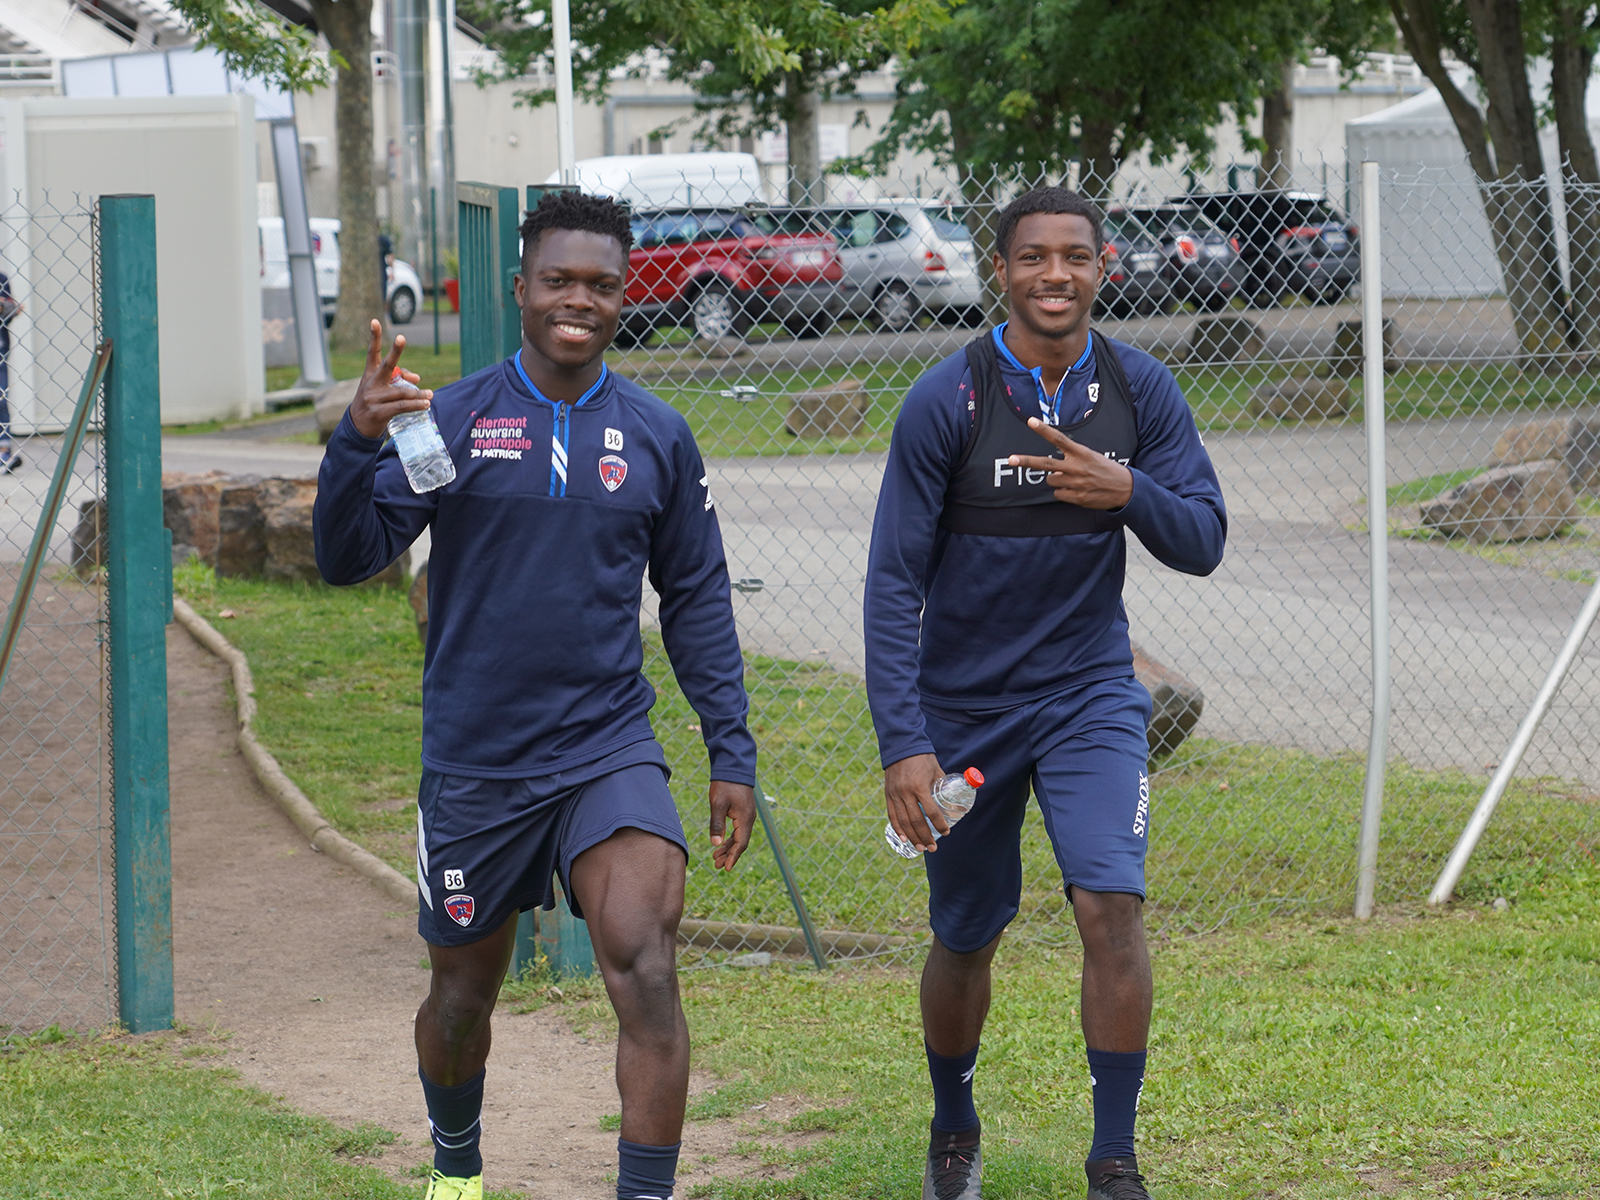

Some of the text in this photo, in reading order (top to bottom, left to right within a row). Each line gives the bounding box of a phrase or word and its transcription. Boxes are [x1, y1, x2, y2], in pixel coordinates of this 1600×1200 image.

[475, 416, 527, 428] clermont
[470, 428, 522, 439] auvergne
[607, 432, 620, 446] 36
[481, 449, 523, 460] PATRICK
[446, 873, 462, 887] 36
